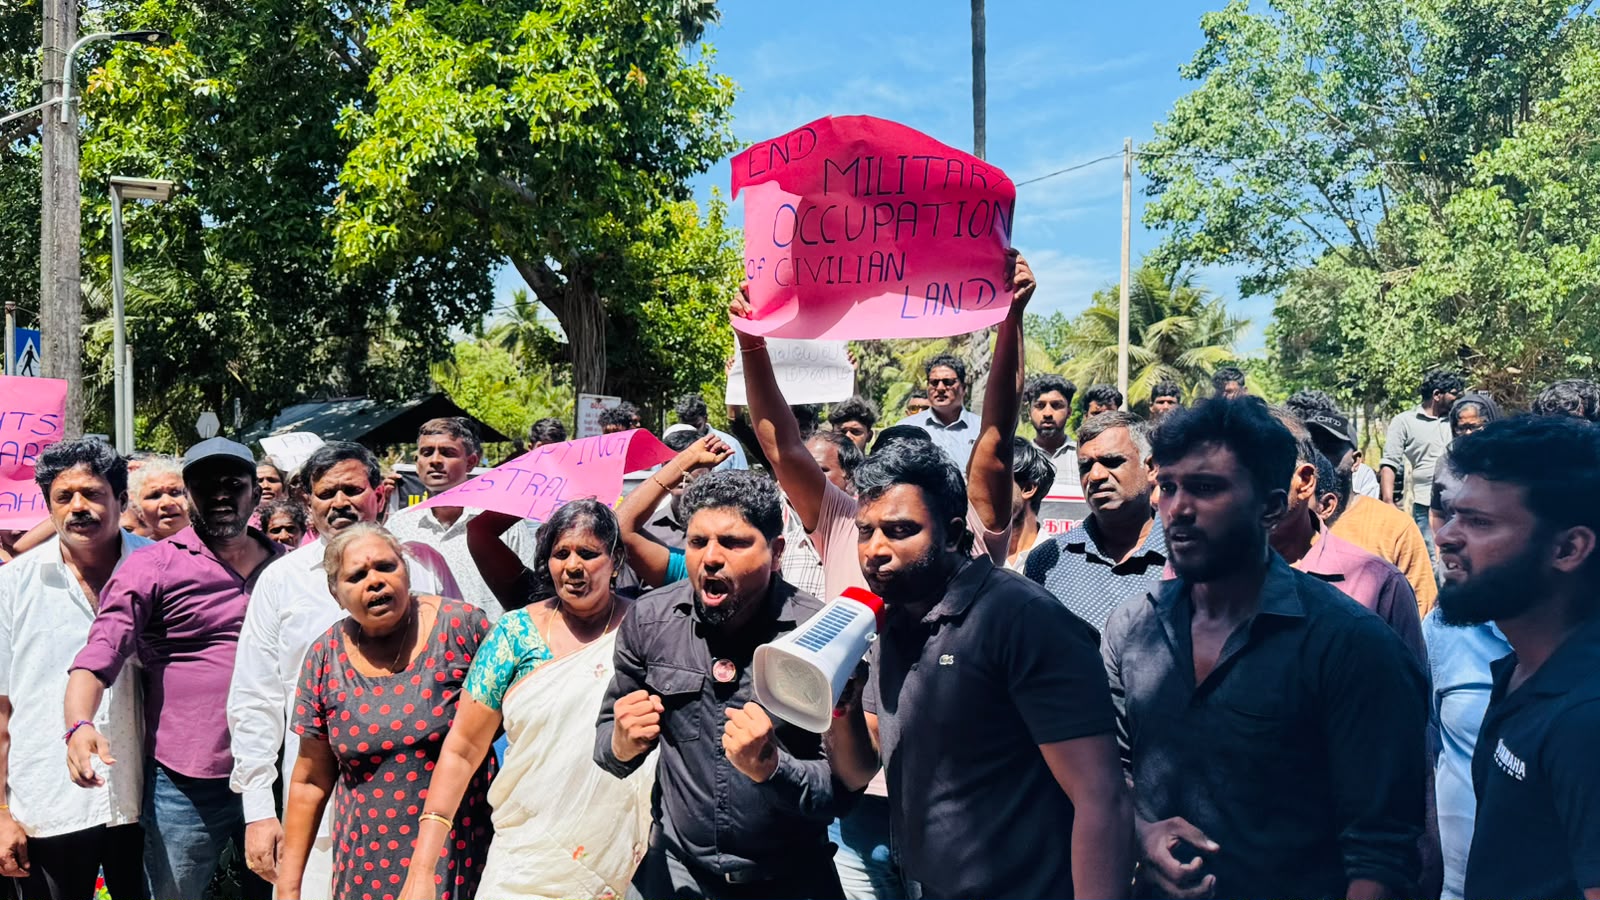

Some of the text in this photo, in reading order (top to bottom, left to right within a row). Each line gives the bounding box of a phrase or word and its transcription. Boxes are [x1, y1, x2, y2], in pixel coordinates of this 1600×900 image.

[749, 127, 817, 177] END
[824, 155, 1008, 197] MILITARY
[773, 199, 1015, 248] OCCUPATION
[775, 251, 906, 287] CIVILIAN
[901, 278, 997, 319] LAND
